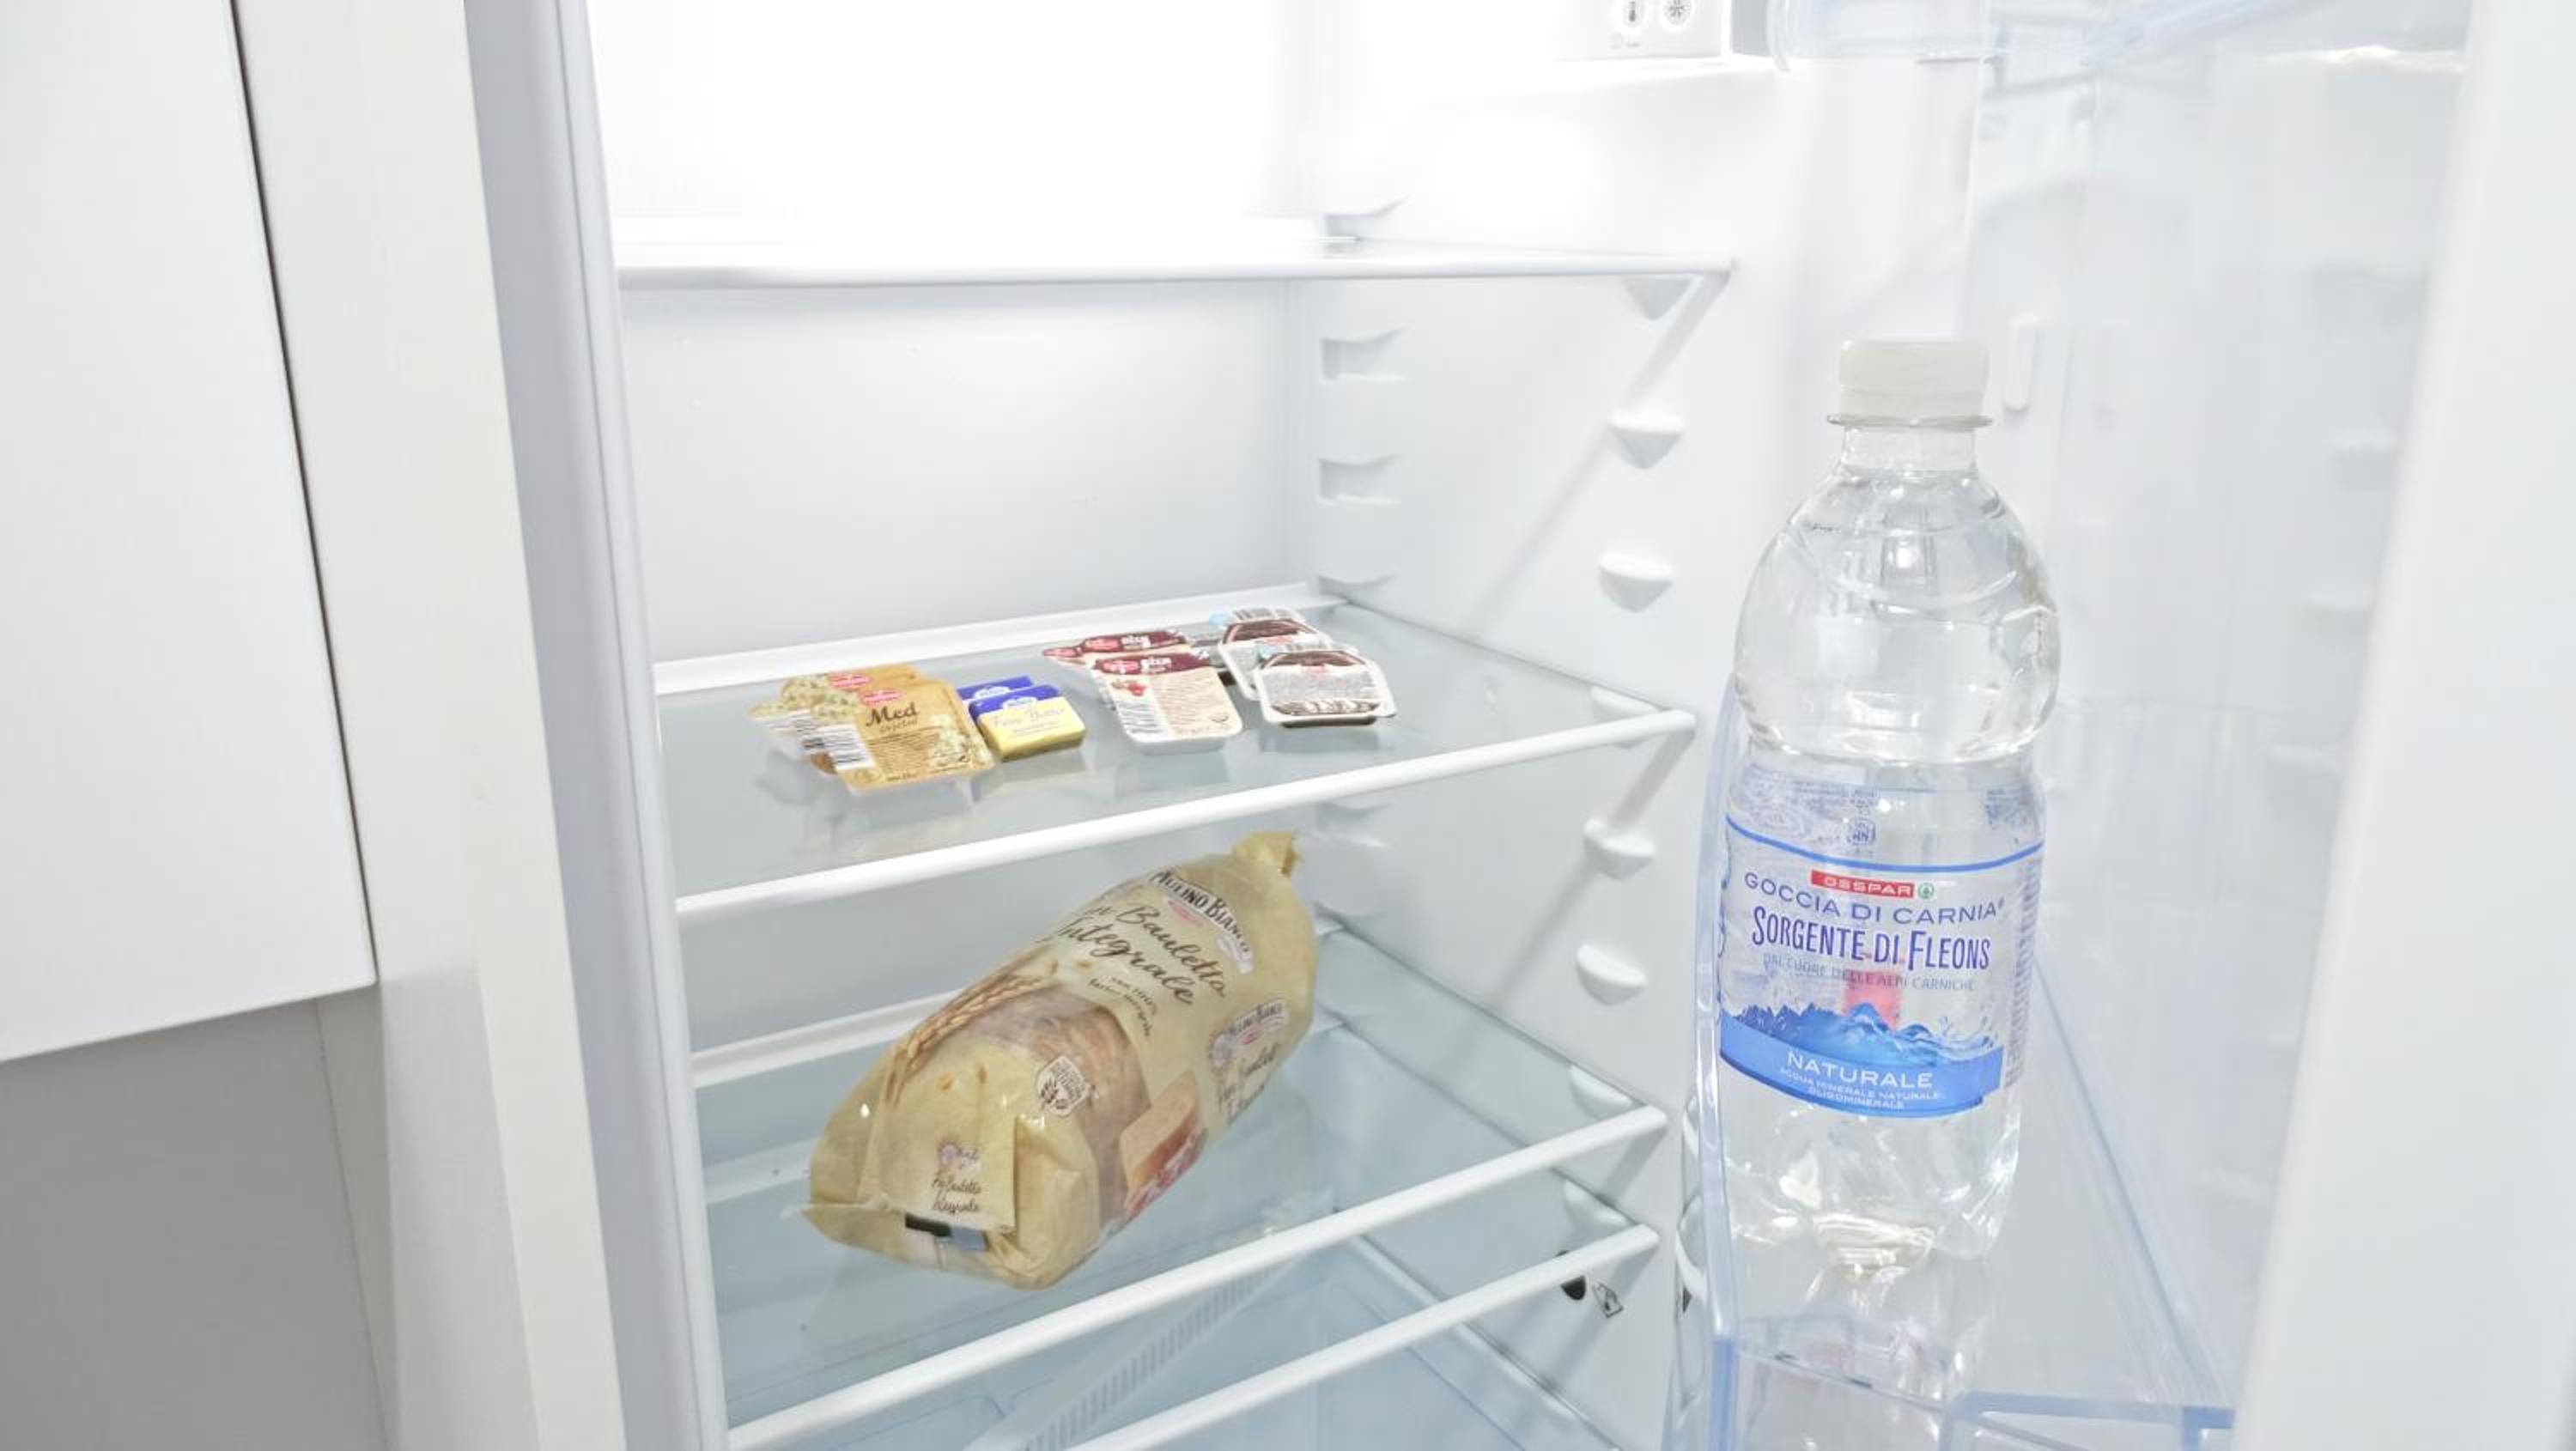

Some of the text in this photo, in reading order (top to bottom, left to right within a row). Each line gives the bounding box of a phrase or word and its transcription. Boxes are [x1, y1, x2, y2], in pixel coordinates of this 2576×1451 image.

[865, 701, 920, 727] Med
[1744, 871, 1841, 917] GOCCIA
[1851, 903, 1880, 921] DI
[1056, 915, 1194, 1005] Integrale
[1115, 906, 1225, 999] Bauletto
[1752, 906, 1991, 971] SORGENTE DI FLEONS
[1787, 1051, 1934, 1089] NATURALE
[1815, 1080, 1875, 1098] MINERALE
